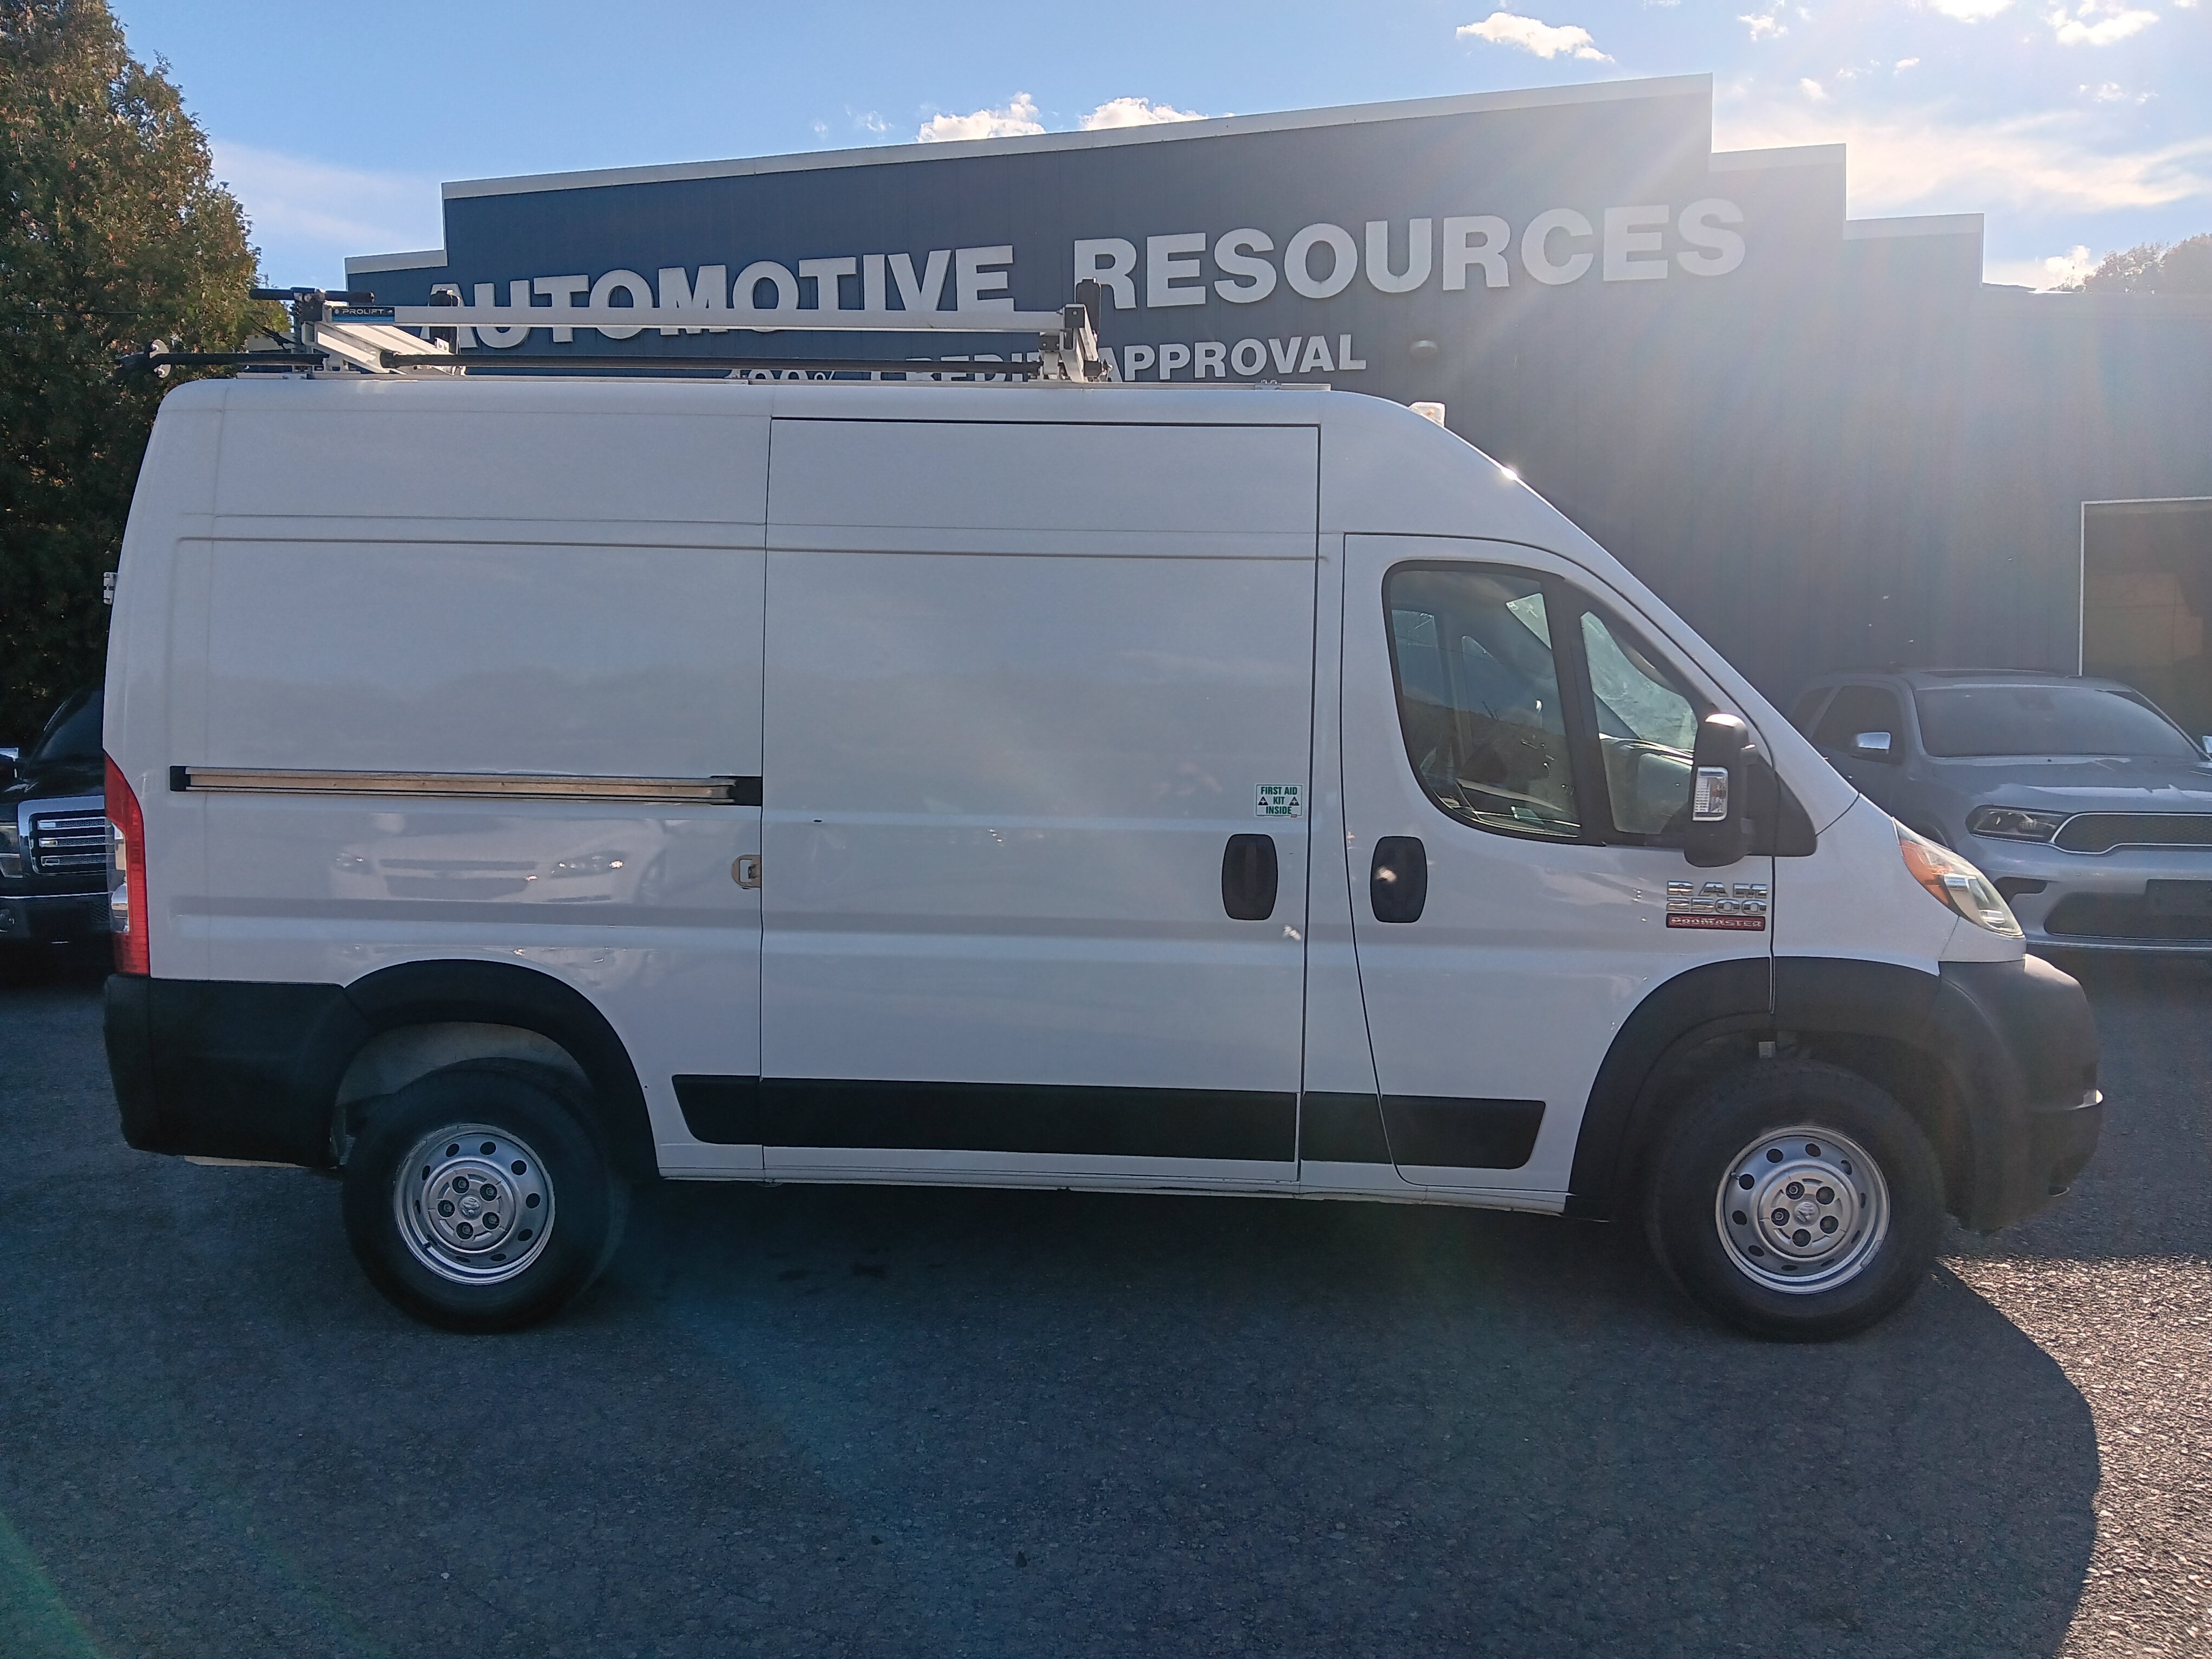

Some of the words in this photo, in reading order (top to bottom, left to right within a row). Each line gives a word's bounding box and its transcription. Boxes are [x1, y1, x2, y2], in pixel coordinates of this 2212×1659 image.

[1074, 198, 1745, 310] RESOURCES
[1097, 334, 1367, 382] APPROVAL
[1261, 787, 1282, 795] FIRST
[1284, 787, 1297, 795] AID
[1273, 796, 1285, 805] KIT
[1266, 806, 1292, 814] INSIDE
[1667, 880, 1767, 899] RAM
[1666, 897, 1767, 915] 2500
